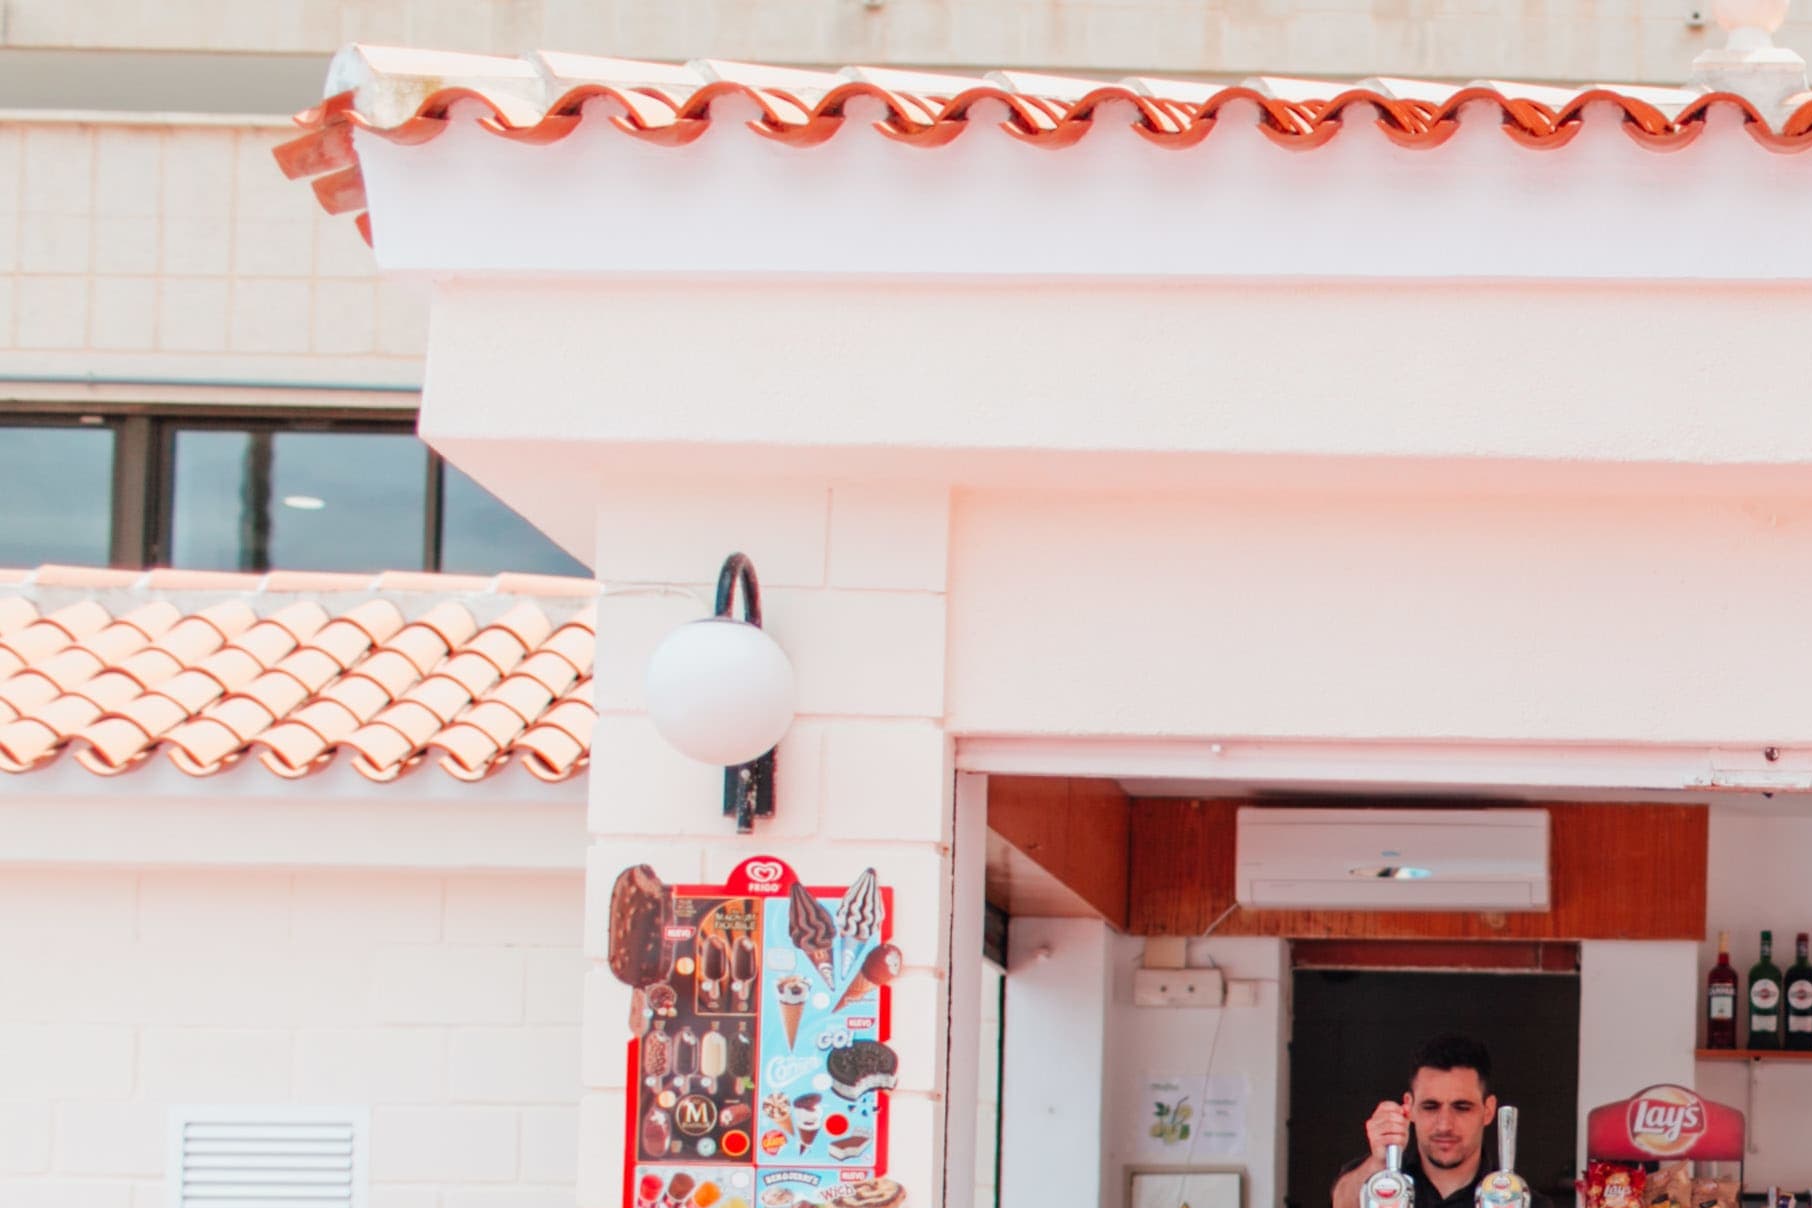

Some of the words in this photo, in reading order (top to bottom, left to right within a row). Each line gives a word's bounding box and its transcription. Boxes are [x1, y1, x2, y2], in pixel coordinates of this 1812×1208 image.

[748, 883, 780, 893] FRIGO
[685, 1102, 709, 1123] M
[1633, 1102, 1699, 1140] Lay's
